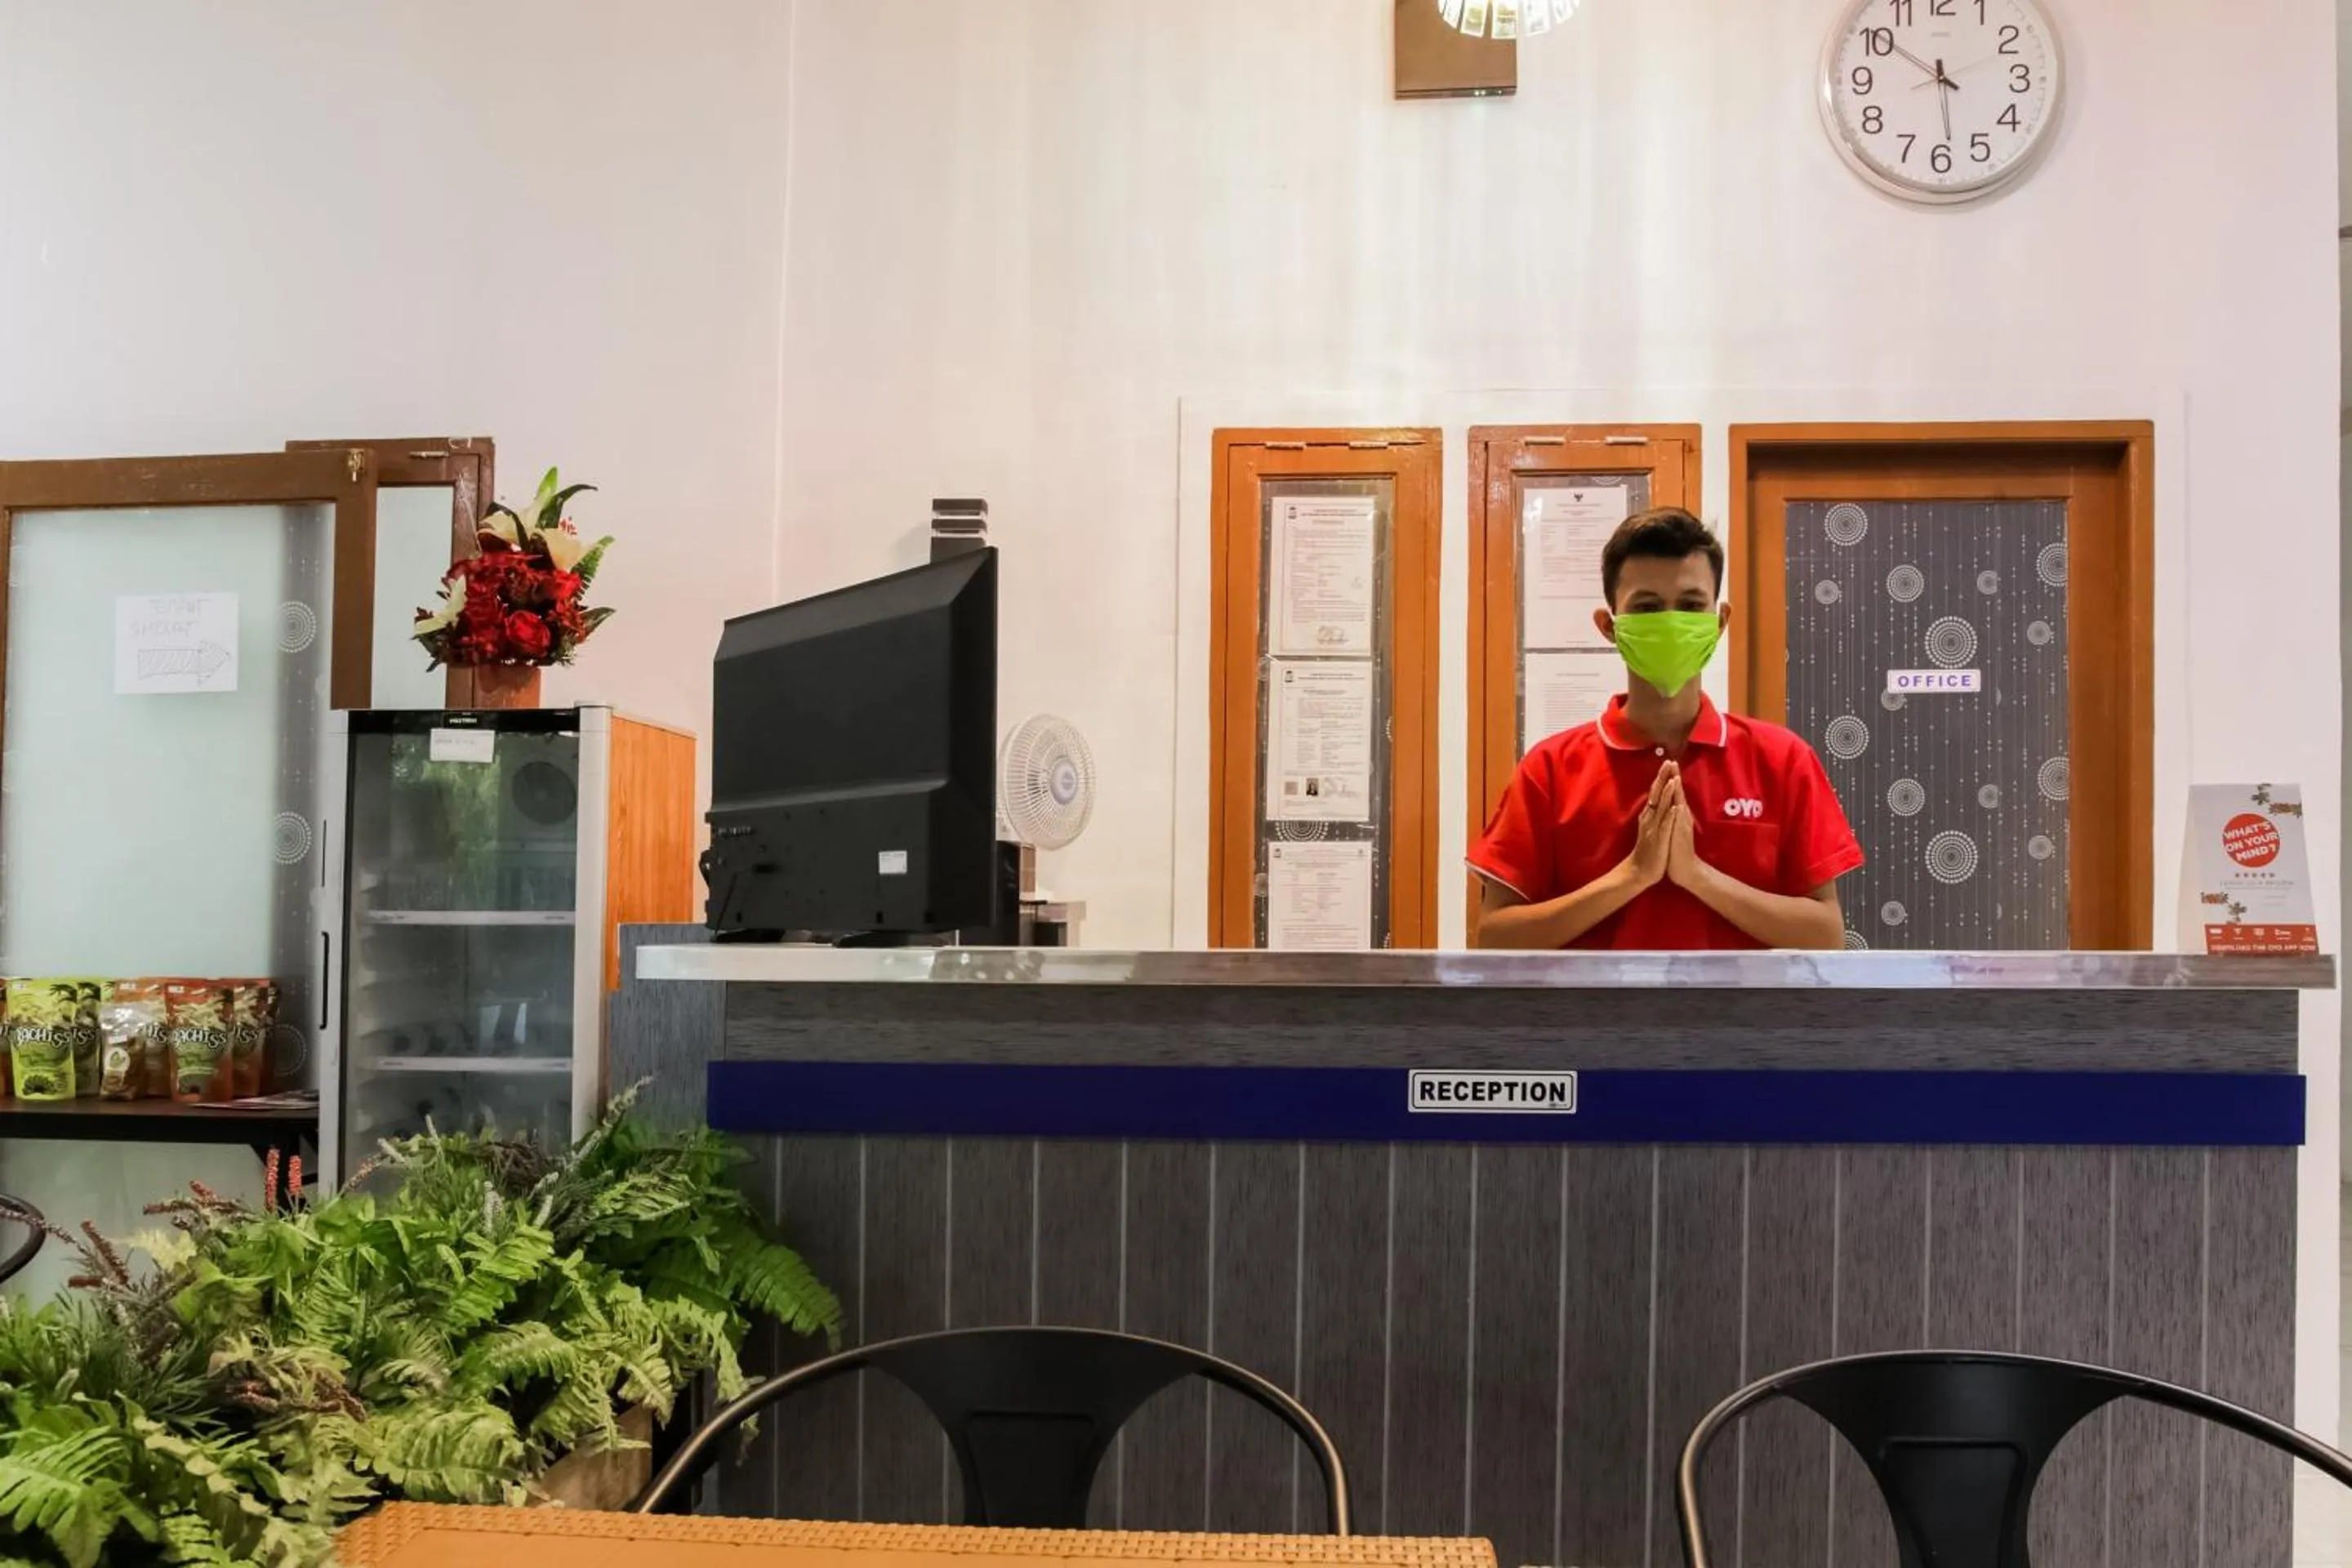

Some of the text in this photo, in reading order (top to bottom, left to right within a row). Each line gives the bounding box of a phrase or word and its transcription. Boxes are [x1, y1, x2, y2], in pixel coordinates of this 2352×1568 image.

[1888, 0, 1913, 27] 11
[1930, 0, 1957, 16] 12
[1973, 0, 1984, 25] 1
[1859, 26, 1895, 56] 10
[1998, 24, 2020, 55] 2
[1851, 66, 1873, 95] 9
[2008, 64, 2031, 93] 3
[1861, 105, 1884, 134] 8
[1996, 103, 2021, 132] 4
[1896, 134, 1917, 163] 7
[1931, 144, 1953, 173] 6
[1970, 133, 1991, 163] 5
[1897, 675, 1972, 688] OFFICE
[1724, 797, 1764, 818] OYO
[2224, 821, 2271, 840] WHAT'S
[2226, 831, 2278, 853] ON YOUR
[1419, 1080, 1566, 1102] RECEPTION
